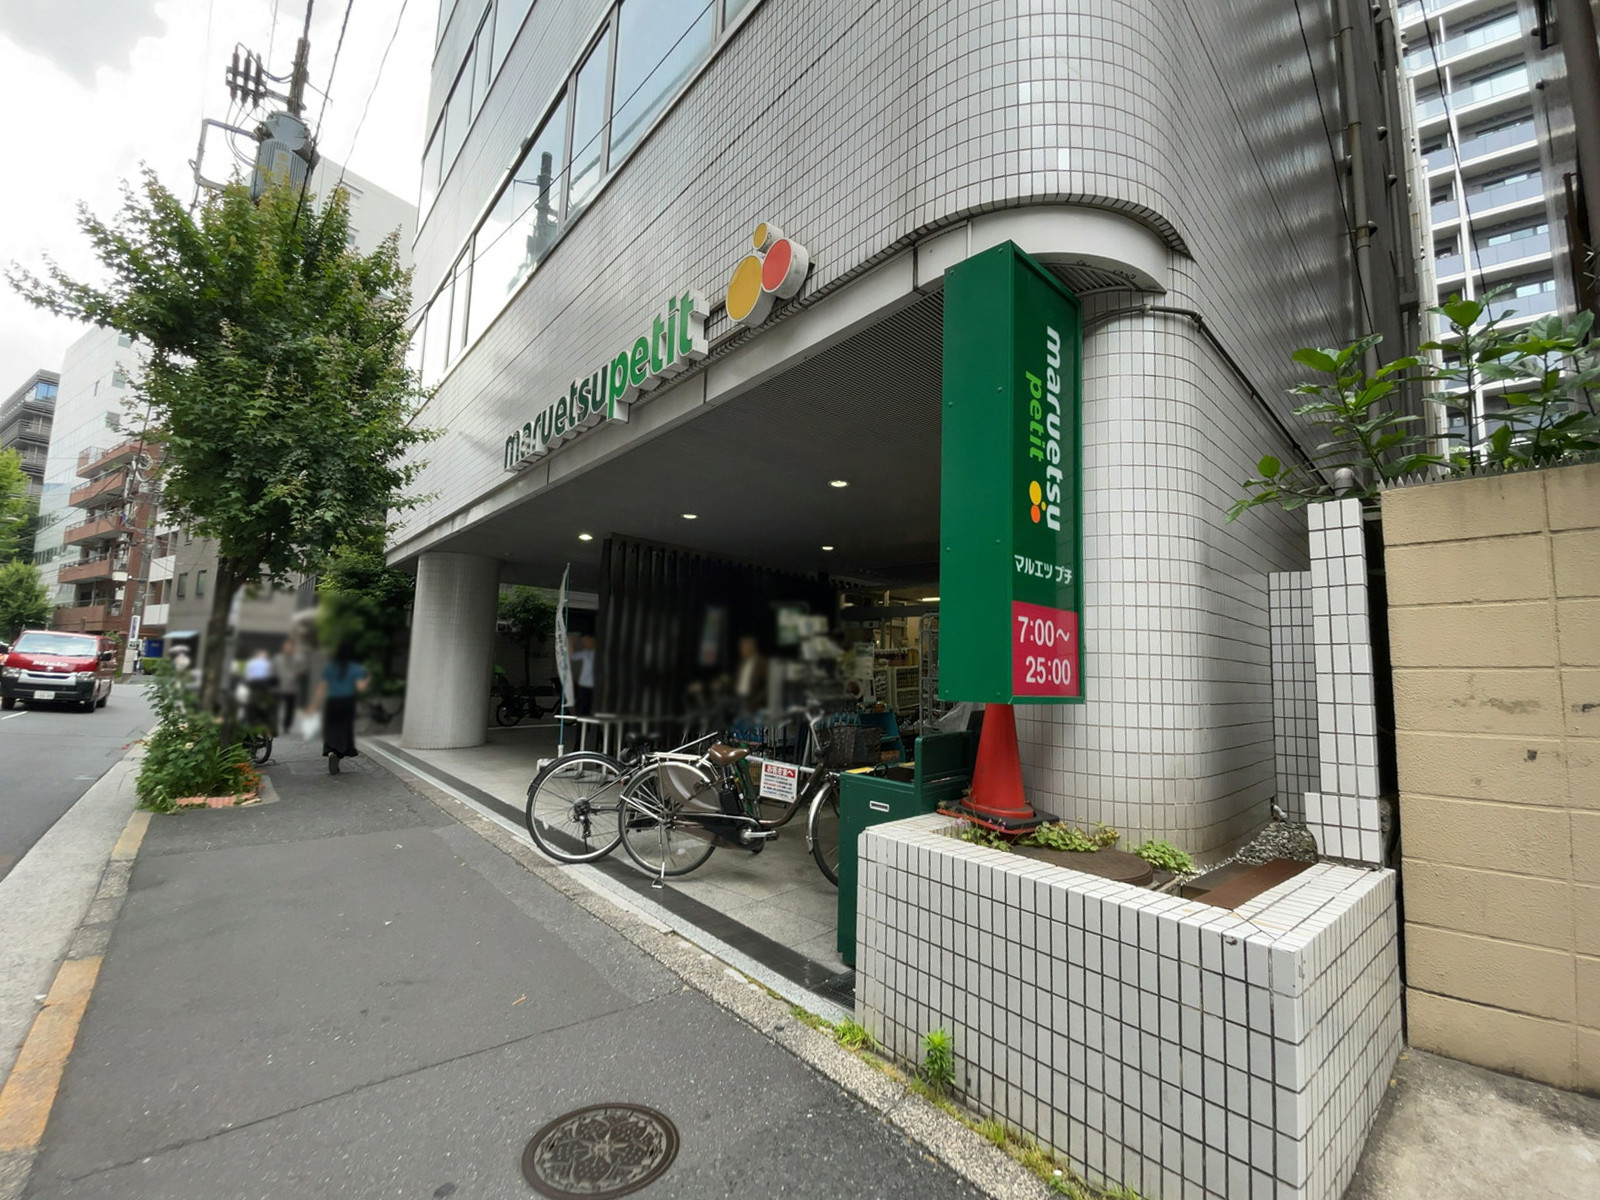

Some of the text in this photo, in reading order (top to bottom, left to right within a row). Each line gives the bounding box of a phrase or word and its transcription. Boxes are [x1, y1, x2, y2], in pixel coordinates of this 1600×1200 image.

[1025, 370, 1046, 462] petit
[1046, 325, 1063, 531] maruetsu
[1025, 655, 1071, 685] 25:00
